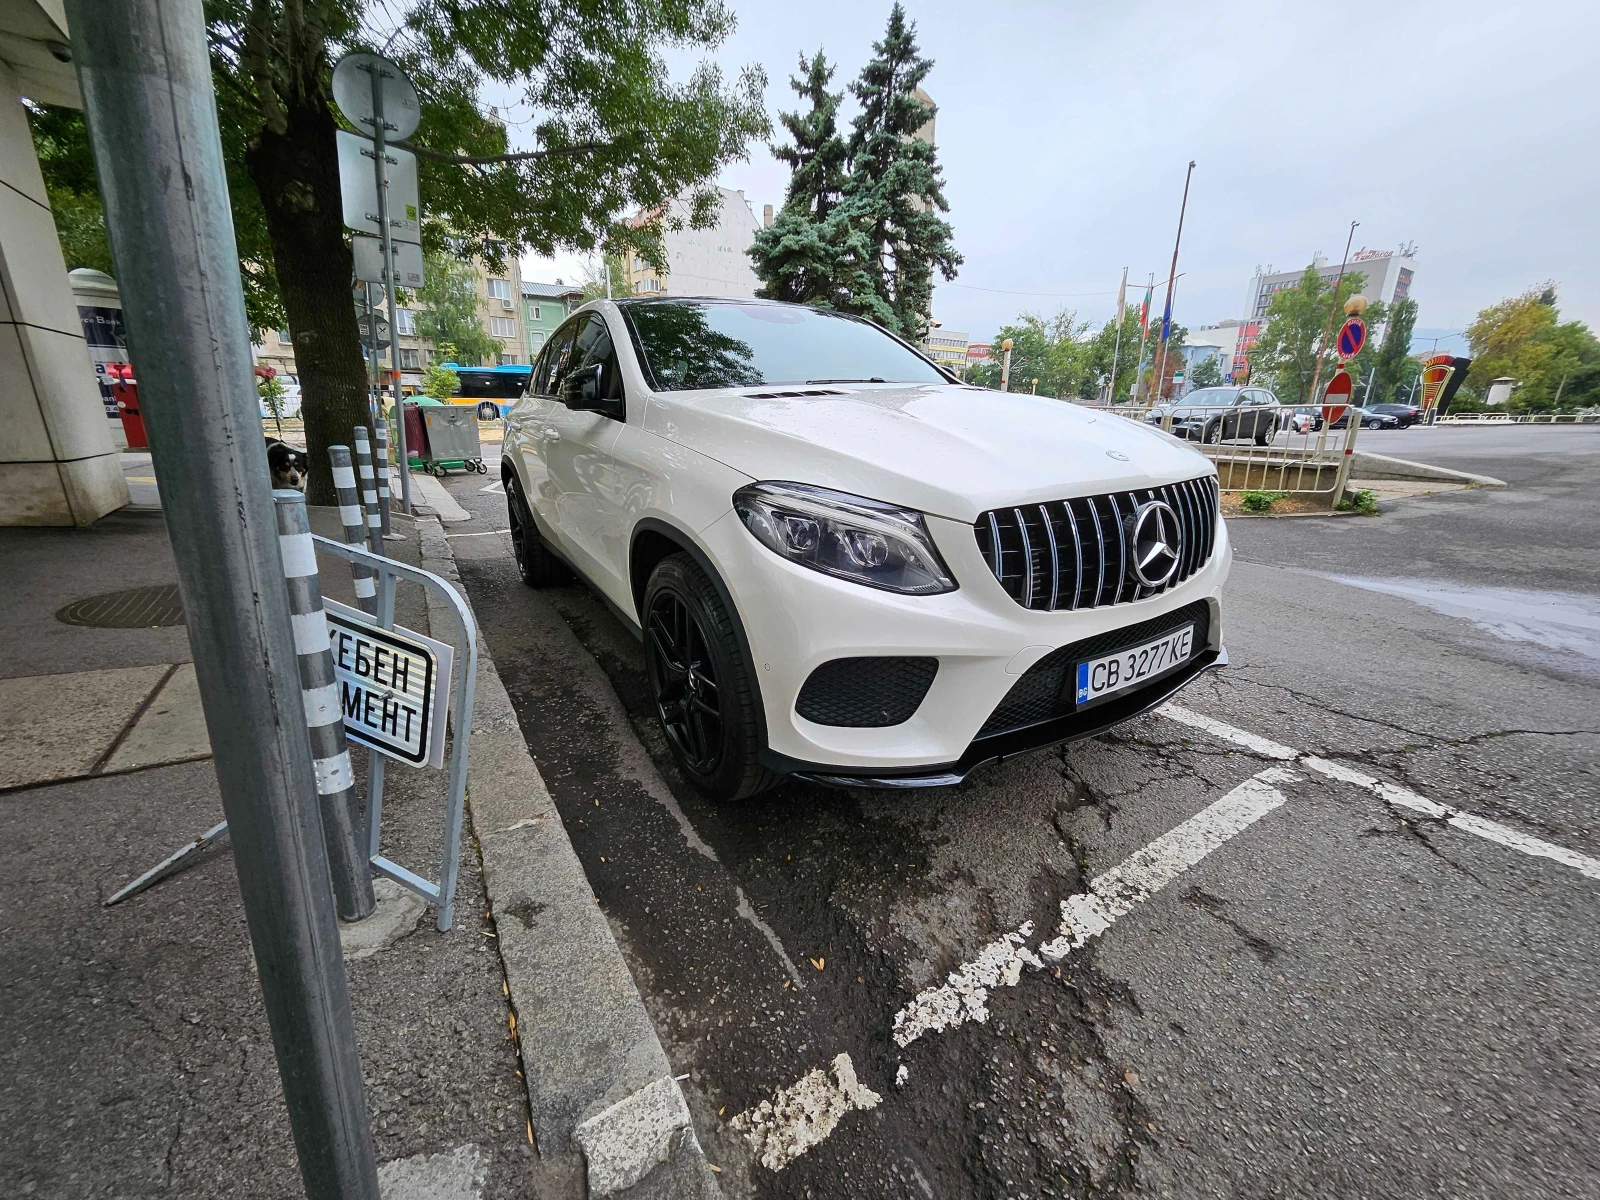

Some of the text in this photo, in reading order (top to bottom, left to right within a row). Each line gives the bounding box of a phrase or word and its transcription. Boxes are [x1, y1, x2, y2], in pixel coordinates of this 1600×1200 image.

[1092, 630, 1191, 692] CB 3277 KE
[1078, 687, 1088, 699] BG
